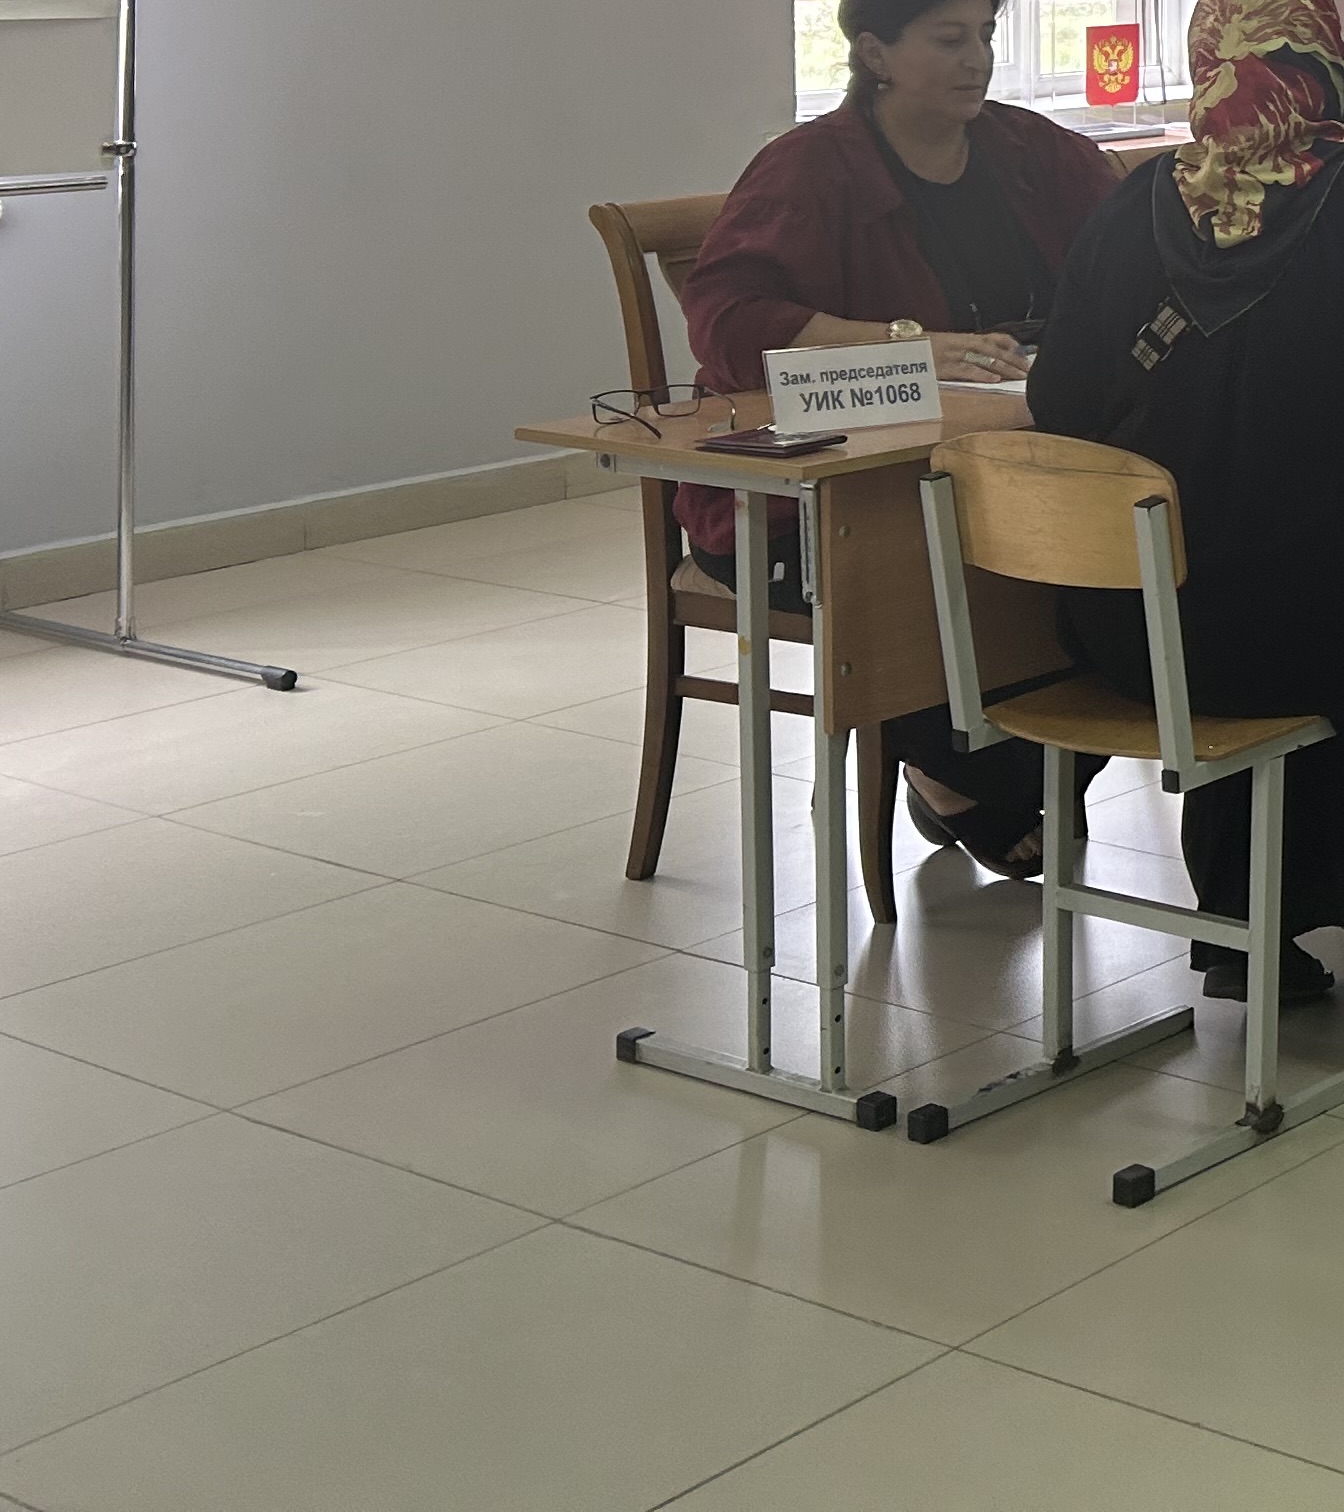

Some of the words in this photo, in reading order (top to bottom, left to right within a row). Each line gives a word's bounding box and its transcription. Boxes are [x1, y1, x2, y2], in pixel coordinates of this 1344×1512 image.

[779, 372, 816, 386] Зам.
[820, 362, 928, 384] председателя
[799, 389, 846, 413] УИК
[851, 382, 921, 408] №1068
